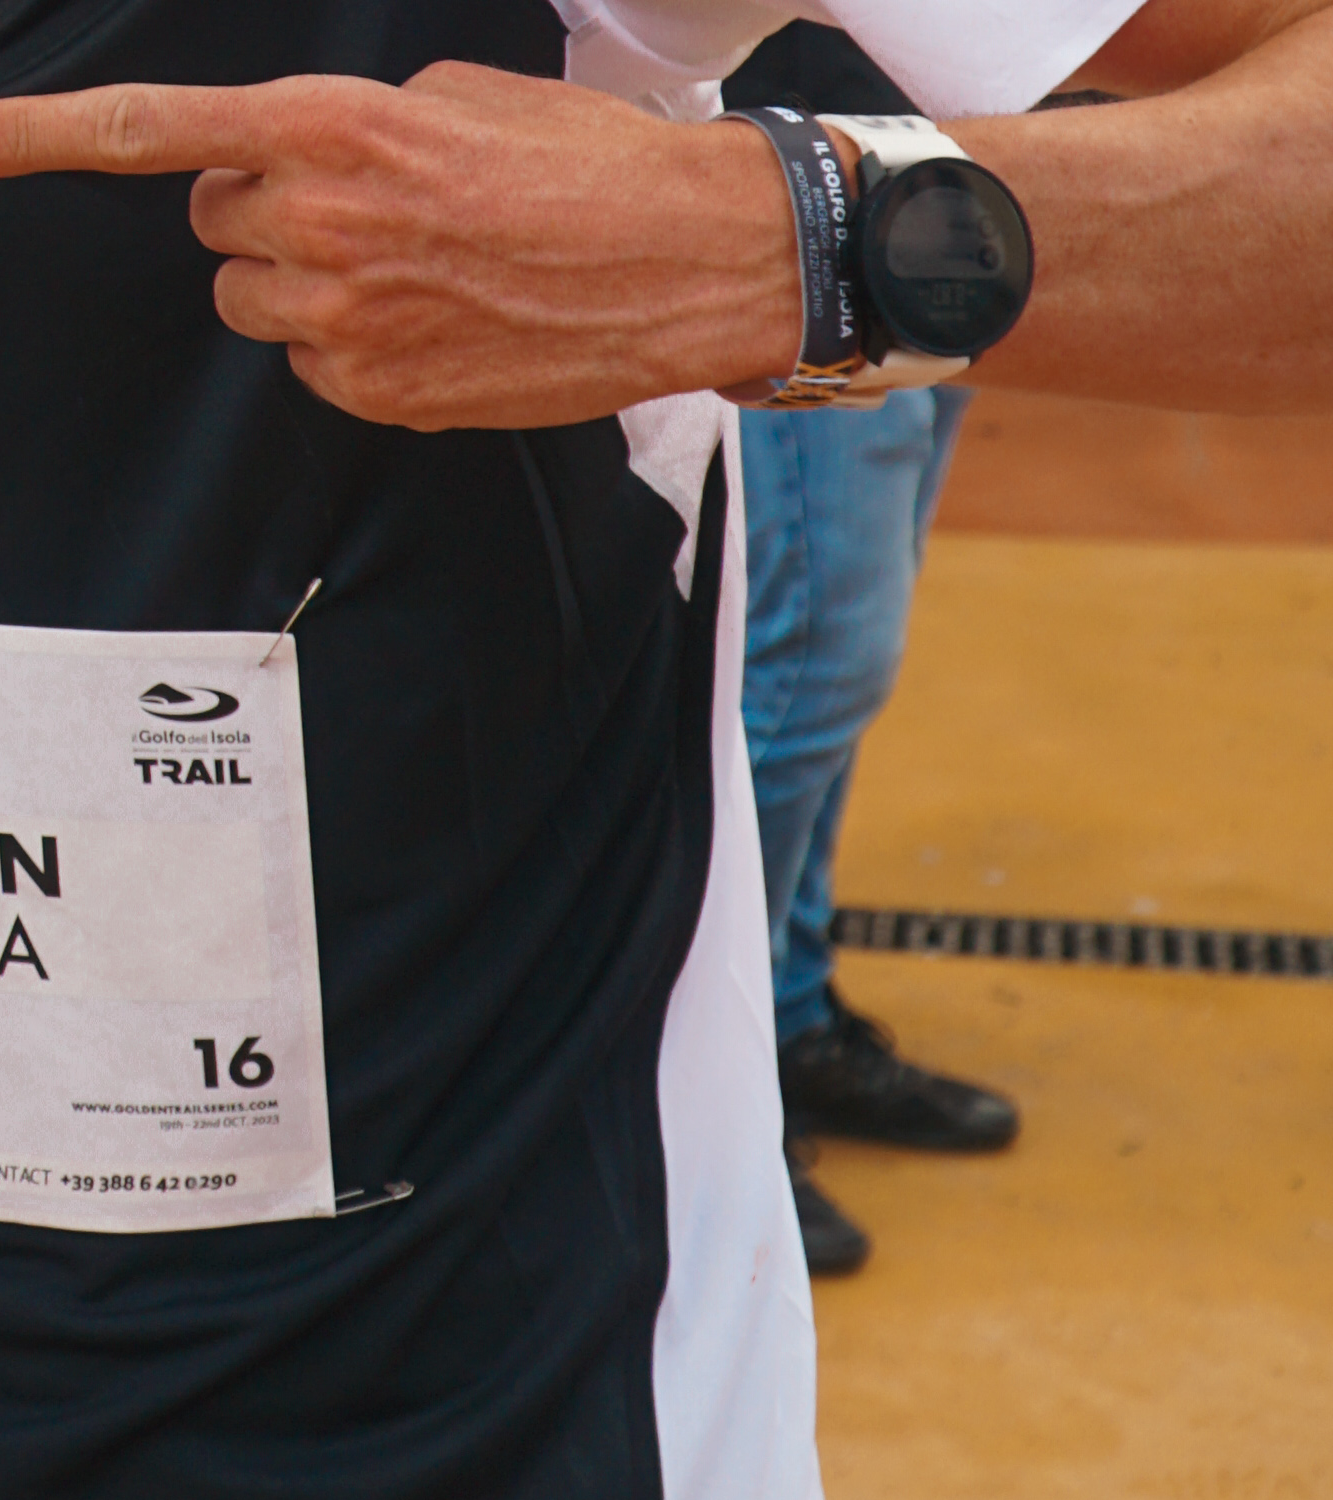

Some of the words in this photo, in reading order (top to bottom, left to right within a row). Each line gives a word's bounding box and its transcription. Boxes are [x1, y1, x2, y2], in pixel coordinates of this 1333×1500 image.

[819, 158, 846, 223] GOLFO
[139, 730, 186, 744] Golfo
[211, 730, 251, 744] Isola
[133, 758, 252, 785] TRAIL
[193, 1035, 275, 1089] 16
[71, 1099, 279, 1115] WWW.GOLDENTRAILSERIES.COM
[61, 1174, 94, 1191] +39
[99, 1175, 135, 1192] 388
[184, 1173, 238, 1191] 0290
